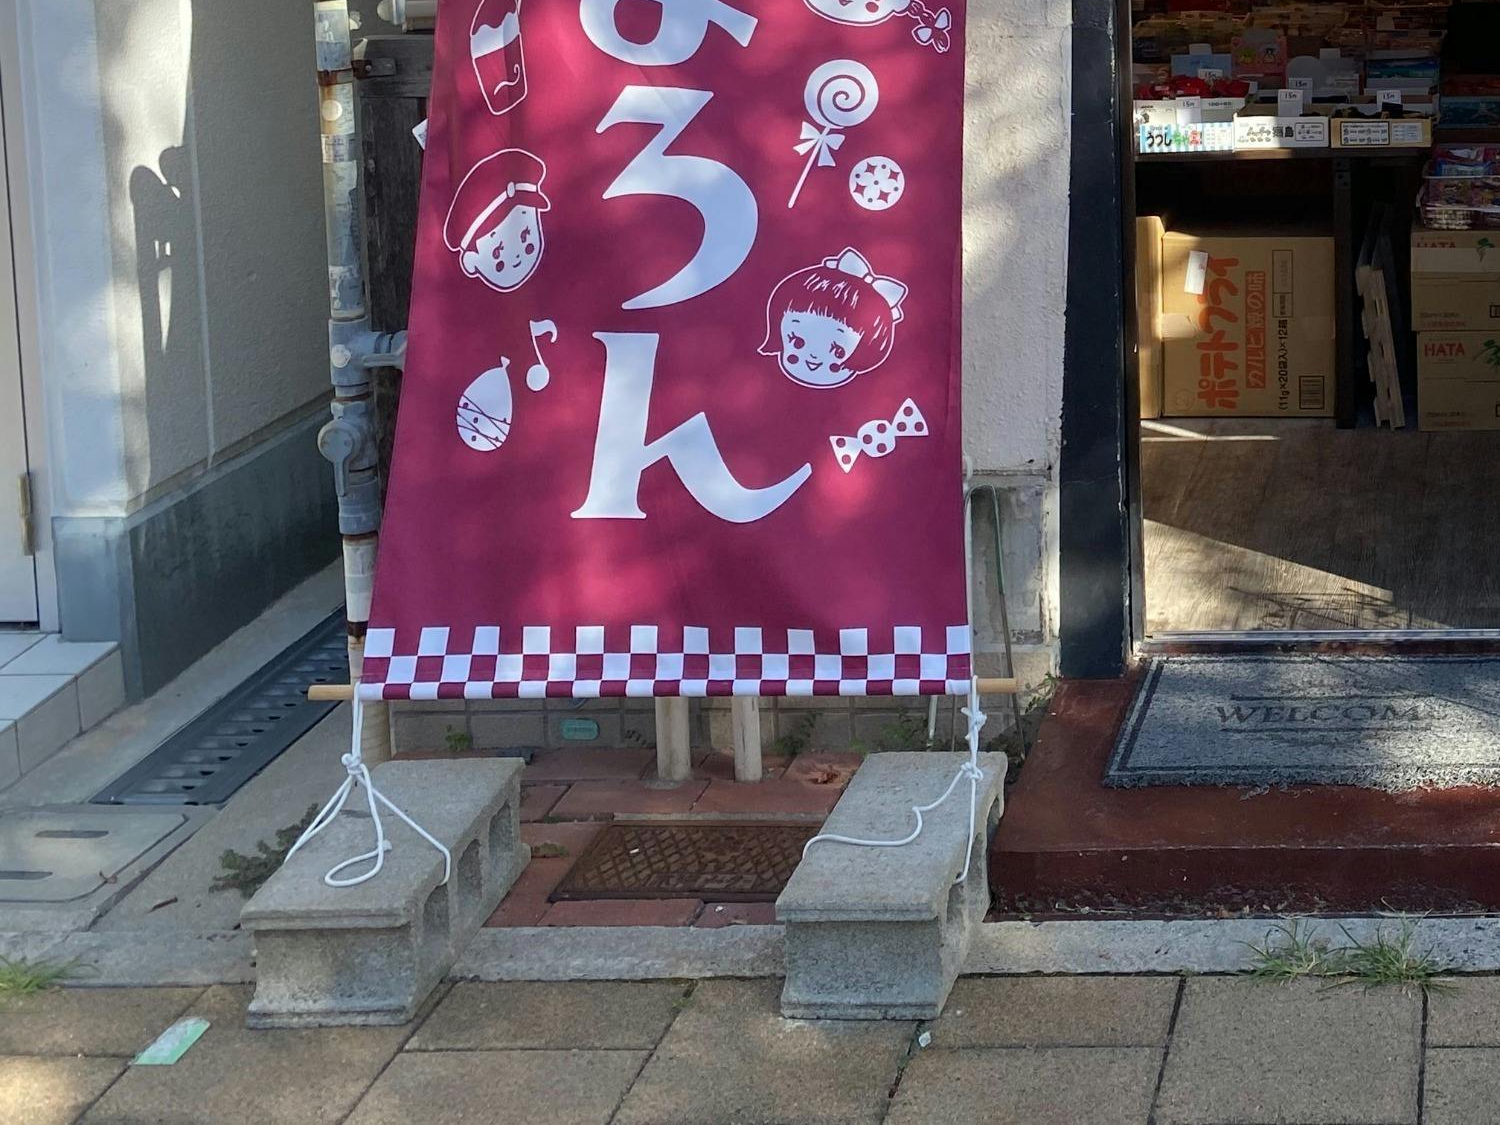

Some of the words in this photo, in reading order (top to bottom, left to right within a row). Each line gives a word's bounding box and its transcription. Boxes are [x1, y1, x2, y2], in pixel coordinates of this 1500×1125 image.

[1196, 257, 1240, 410] ポテトフライ
[1424, 343, 1465, 358] HATA
